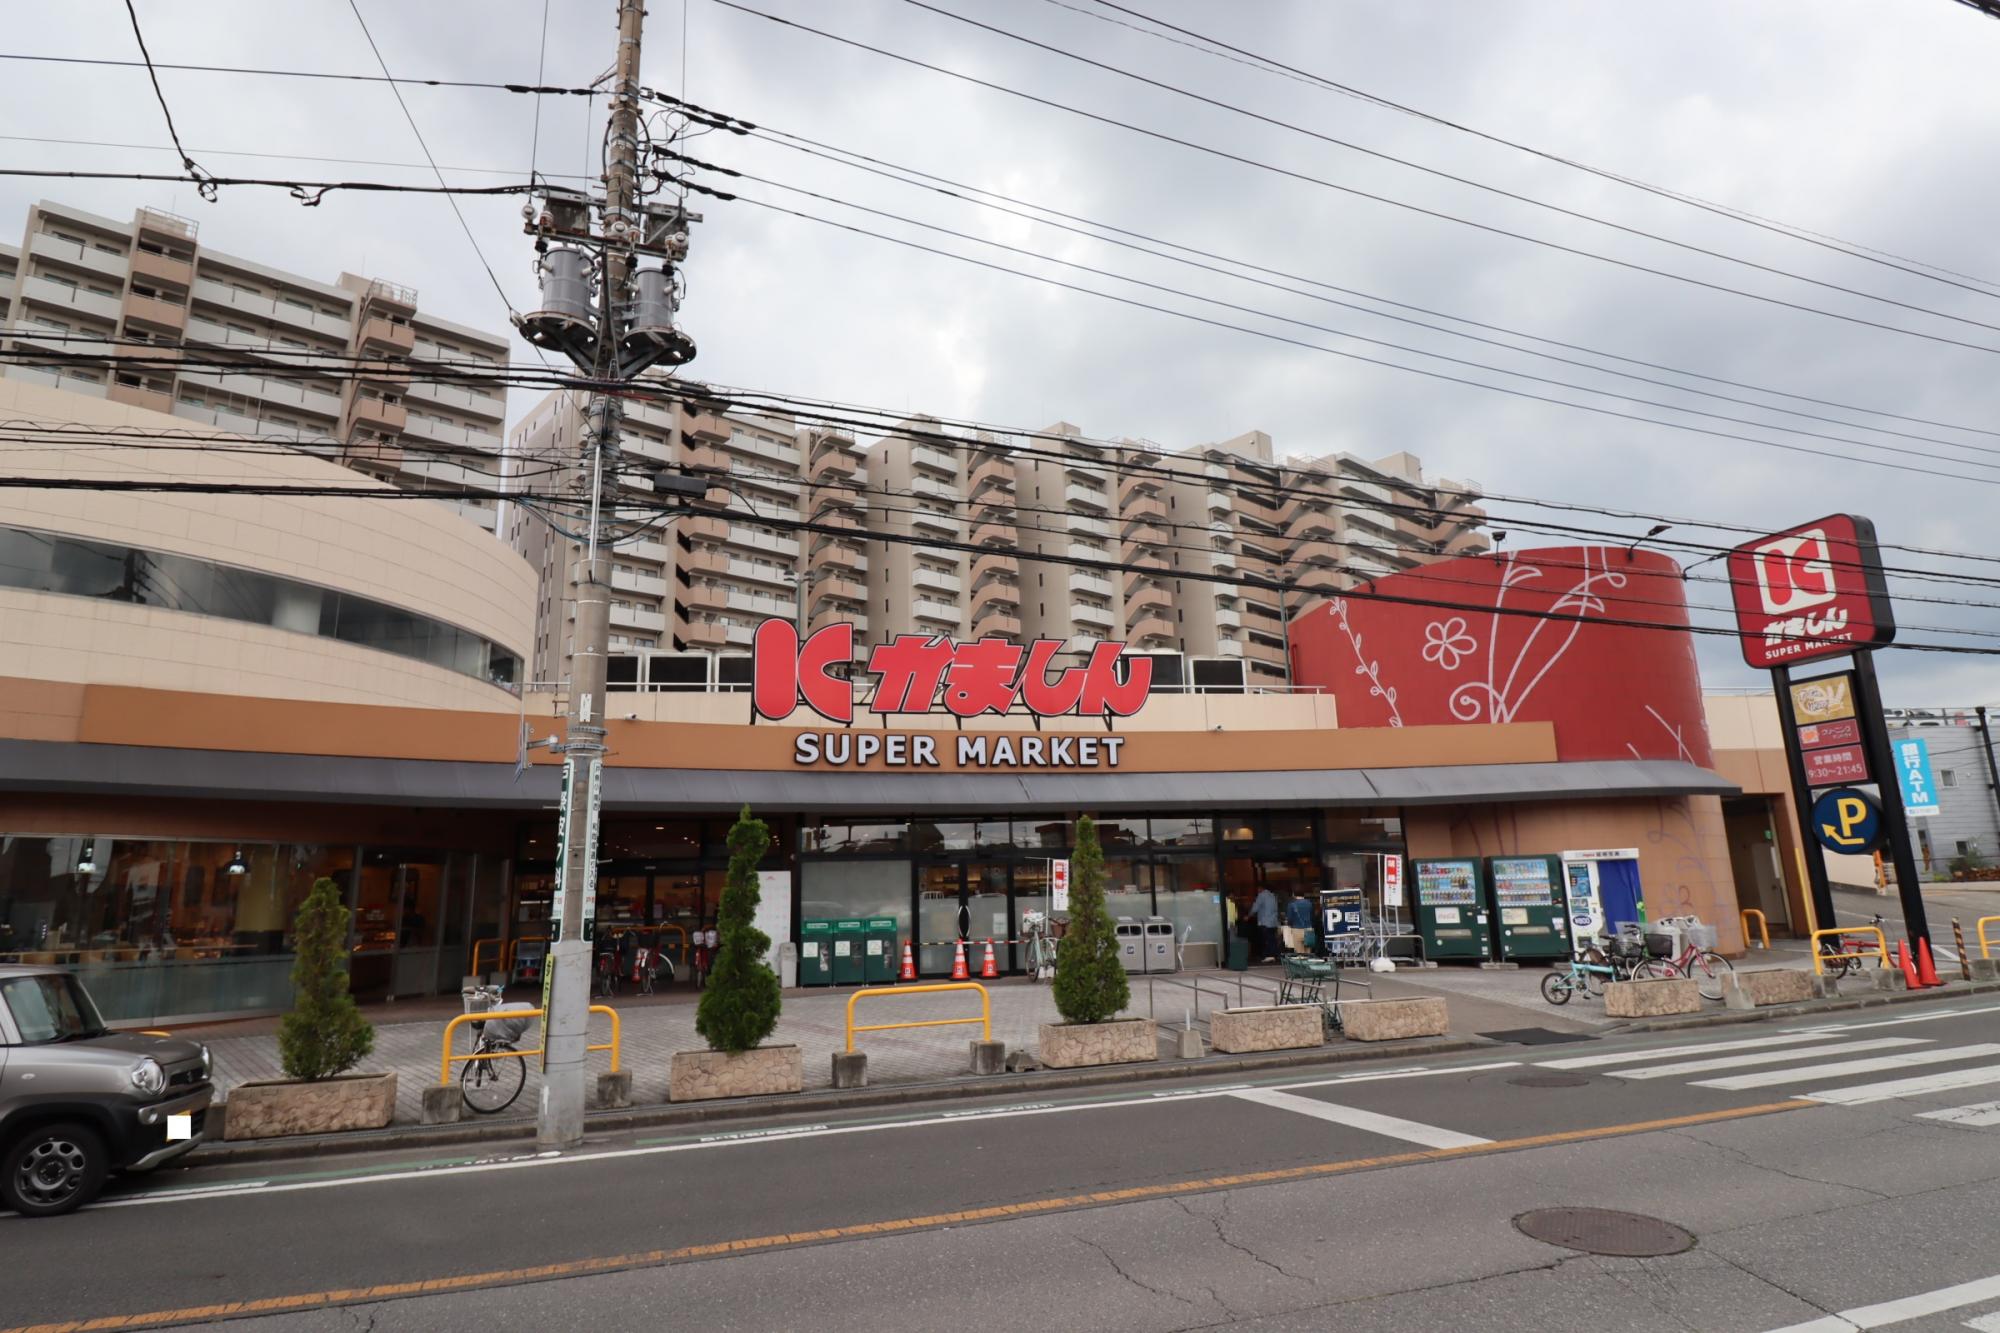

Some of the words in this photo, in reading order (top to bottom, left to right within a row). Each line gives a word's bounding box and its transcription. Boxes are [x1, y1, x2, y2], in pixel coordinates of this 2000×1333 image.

[1763, 606, 1848, 647] かましん
[1765, 644, 1801, 660] SUPER
[868, 634, 1153, 717] かましん
[795, 732, 940, 768] SUPER
[957, 735, 1125, 769] MARKET
[1813, 752, 1853, 765] 営業時間
[1900, 743, 1929, 803] 銀行ATM
[1837, 797, 1867, 837] P
[1325, 909, 1342, 931] P
